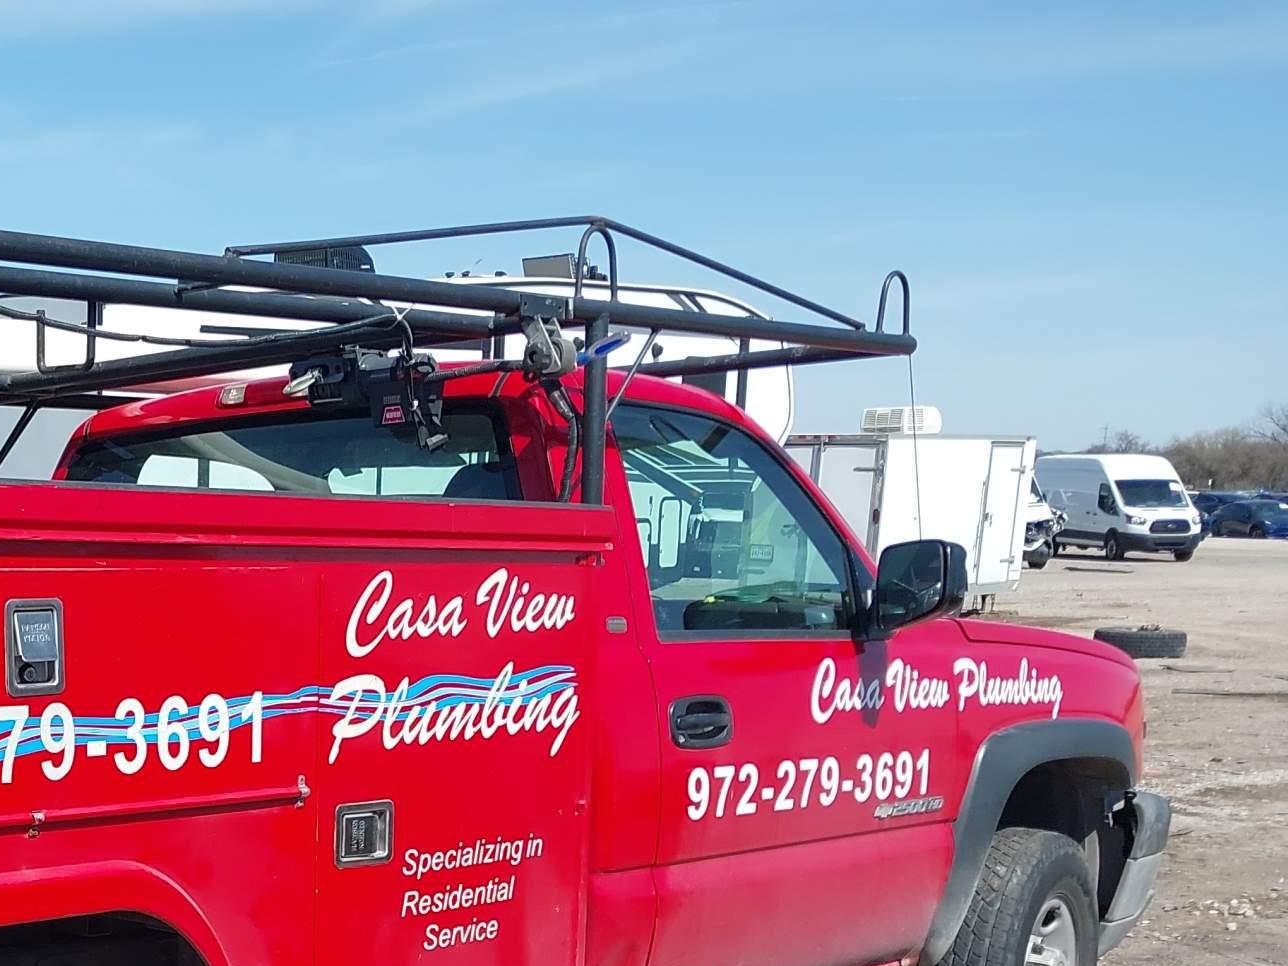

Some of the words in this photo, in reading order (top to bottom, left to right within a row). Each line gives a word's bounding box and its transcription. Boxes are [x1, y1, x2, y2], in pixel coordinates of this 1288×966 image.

[346, 570, 467, 658] Casa
[476, 568, 575, 638] View
[328, 661, 580, 765] Plumbing
[811, 657, 884, 724] Casa
[886, 657, 949, 712] View
[954, 656, 1063, 719] Plumbing
[687, 748, 930, 821] 972-279-3691
[402, 836, 523, 880] Specializing
[526, 833, 543, 858] in
[401, 875, 516, 917] Residential
[423, 917, 499, 951] Service
